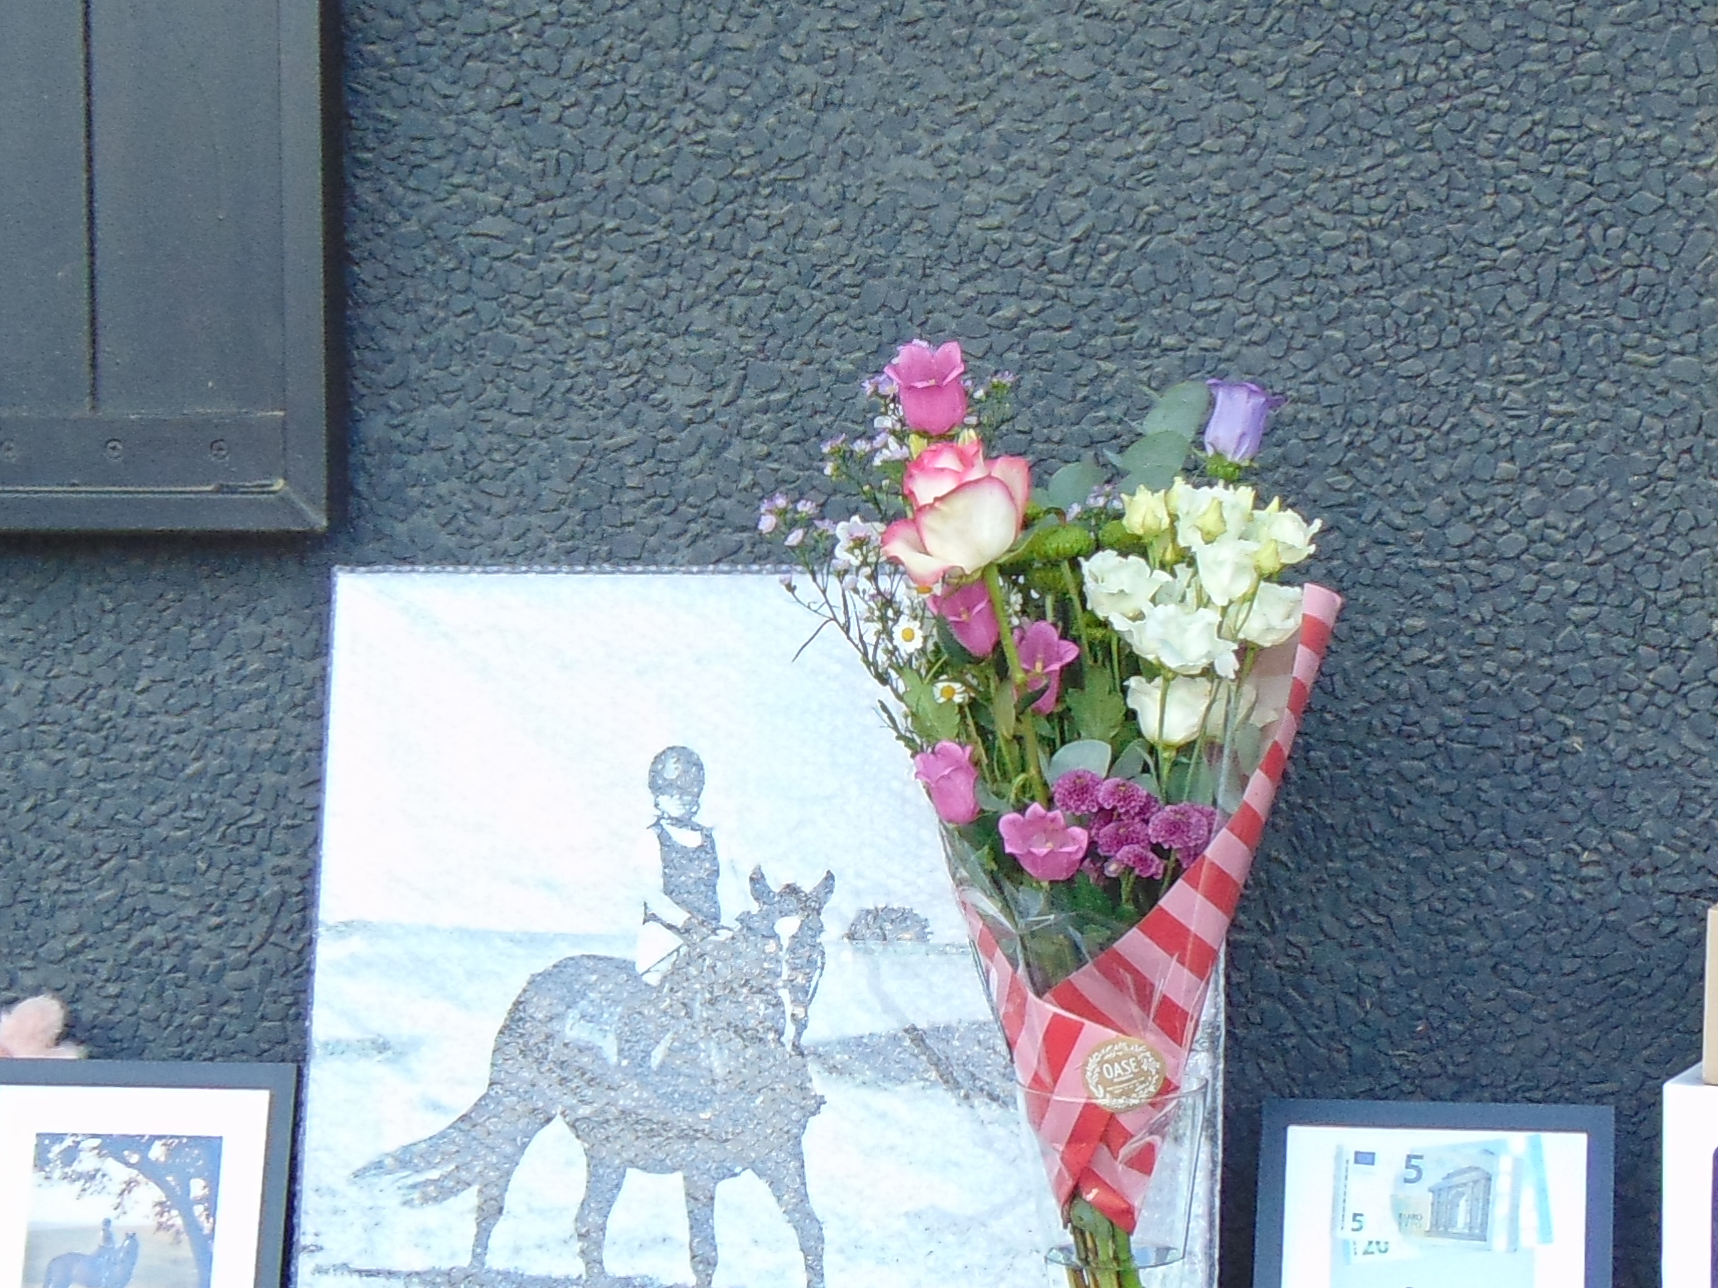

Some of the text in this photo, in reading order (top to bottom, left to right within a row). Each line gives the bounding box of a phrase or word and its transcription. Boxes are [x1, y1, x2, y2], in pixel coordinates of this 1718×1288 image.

[1102, 1057, 1140, 1079] OASE
[1402, 1154, 1424, 1184] 5
[1351, 1212, 1365, 1232] 5
